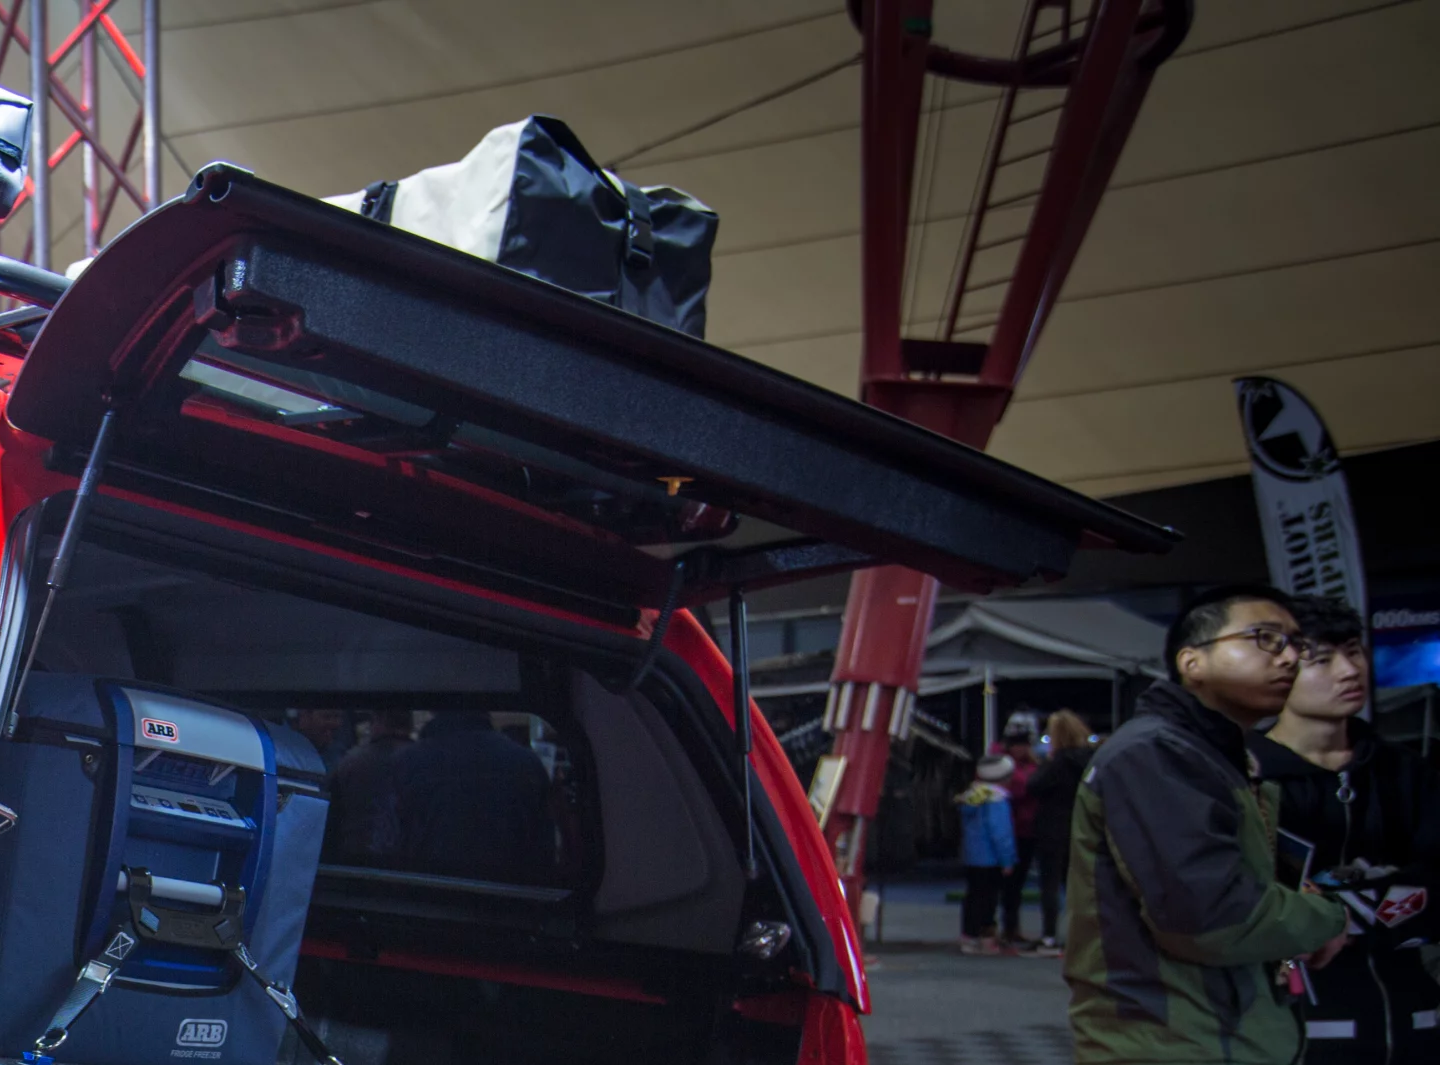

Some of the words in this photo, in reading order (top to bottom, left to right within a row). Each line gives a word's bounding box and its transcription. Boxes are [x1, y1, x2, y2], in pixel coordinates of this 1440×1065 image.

[148, 722, 175, 738] ARB
[180, 1023, 223, 1043] ARB
[170, 1049, 194, 1058] FRIDGE
